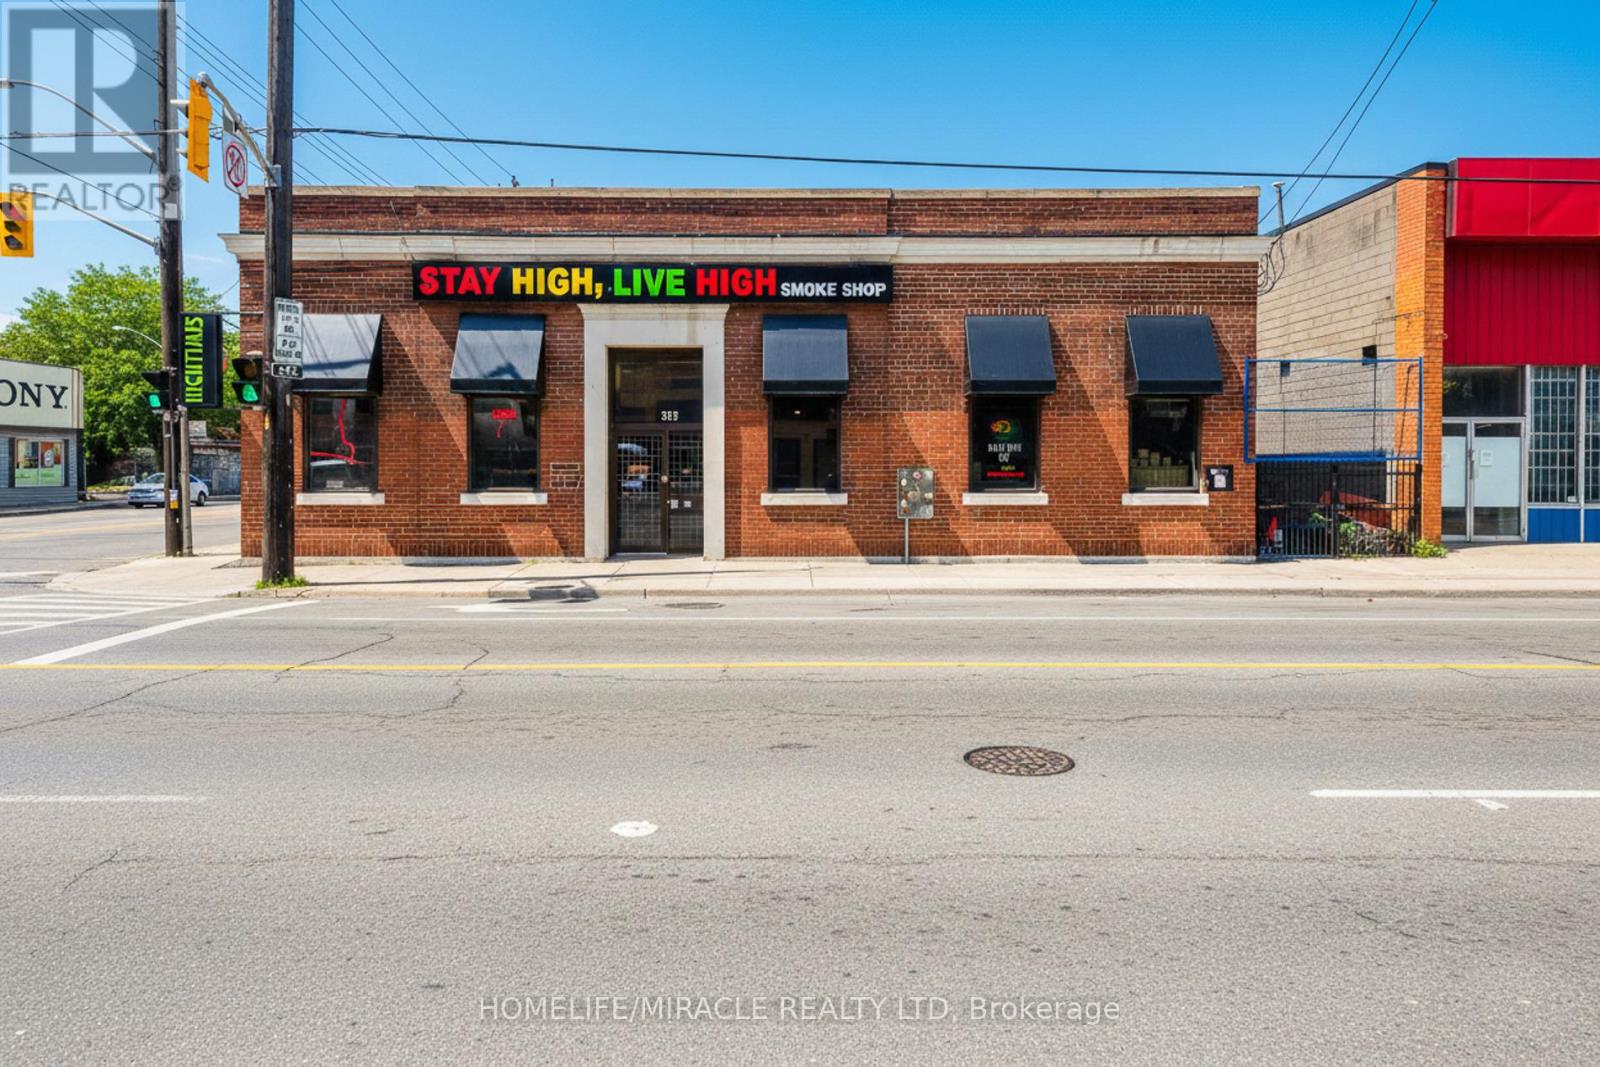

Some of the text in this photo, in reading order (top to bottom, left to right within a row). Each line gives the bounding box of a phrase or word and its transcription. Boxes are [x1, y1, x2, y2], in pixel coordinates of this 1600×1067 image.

[419, 266, 886, 299] STAY HIGH, LIVE HIGH SMOKE SHOP
